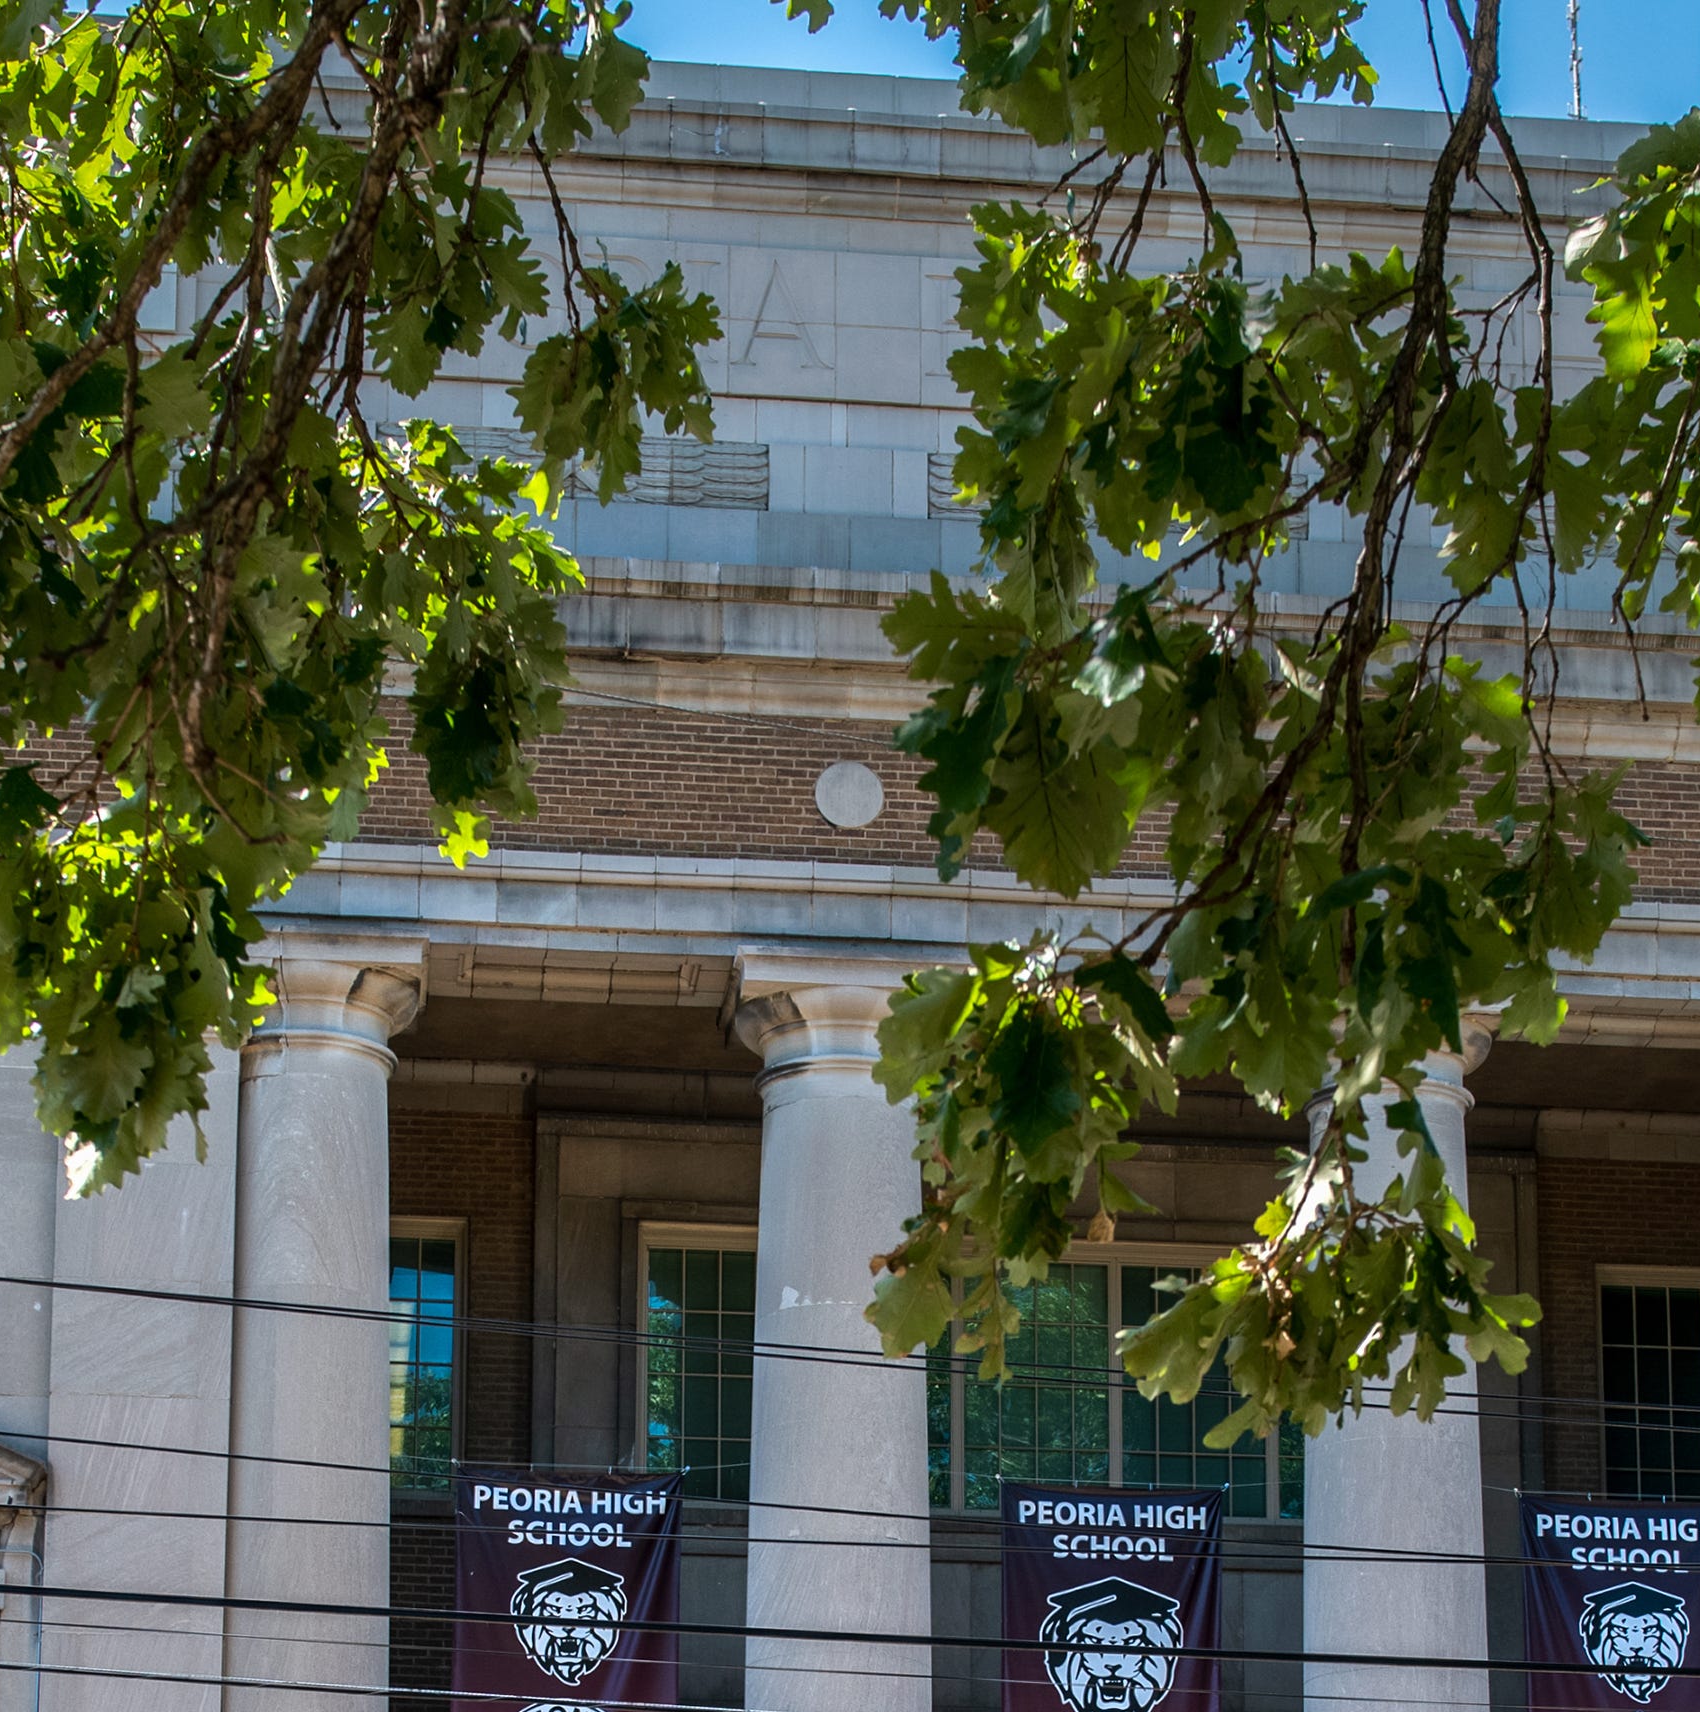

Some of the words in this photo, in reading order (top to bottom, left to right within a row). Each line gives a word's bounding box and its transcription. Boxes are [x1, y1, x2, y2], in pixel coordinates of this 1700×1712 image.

[474, 1485, 582, 1515] PEORIA
[591, 1490, 667, 1515] HIGH
[1017, 1500, 1126, 1528] PEORIA
[1134, 1504, 1207, 1531] HIGH
[1536, 1514, 1642, 1541] PEORIA
[507, 1519, 632, 1548] SCHOOL
[1052, 1534, 1174, 1563] SCHOOL
[1571, 1546, 1689, 1574] SCHOOL
